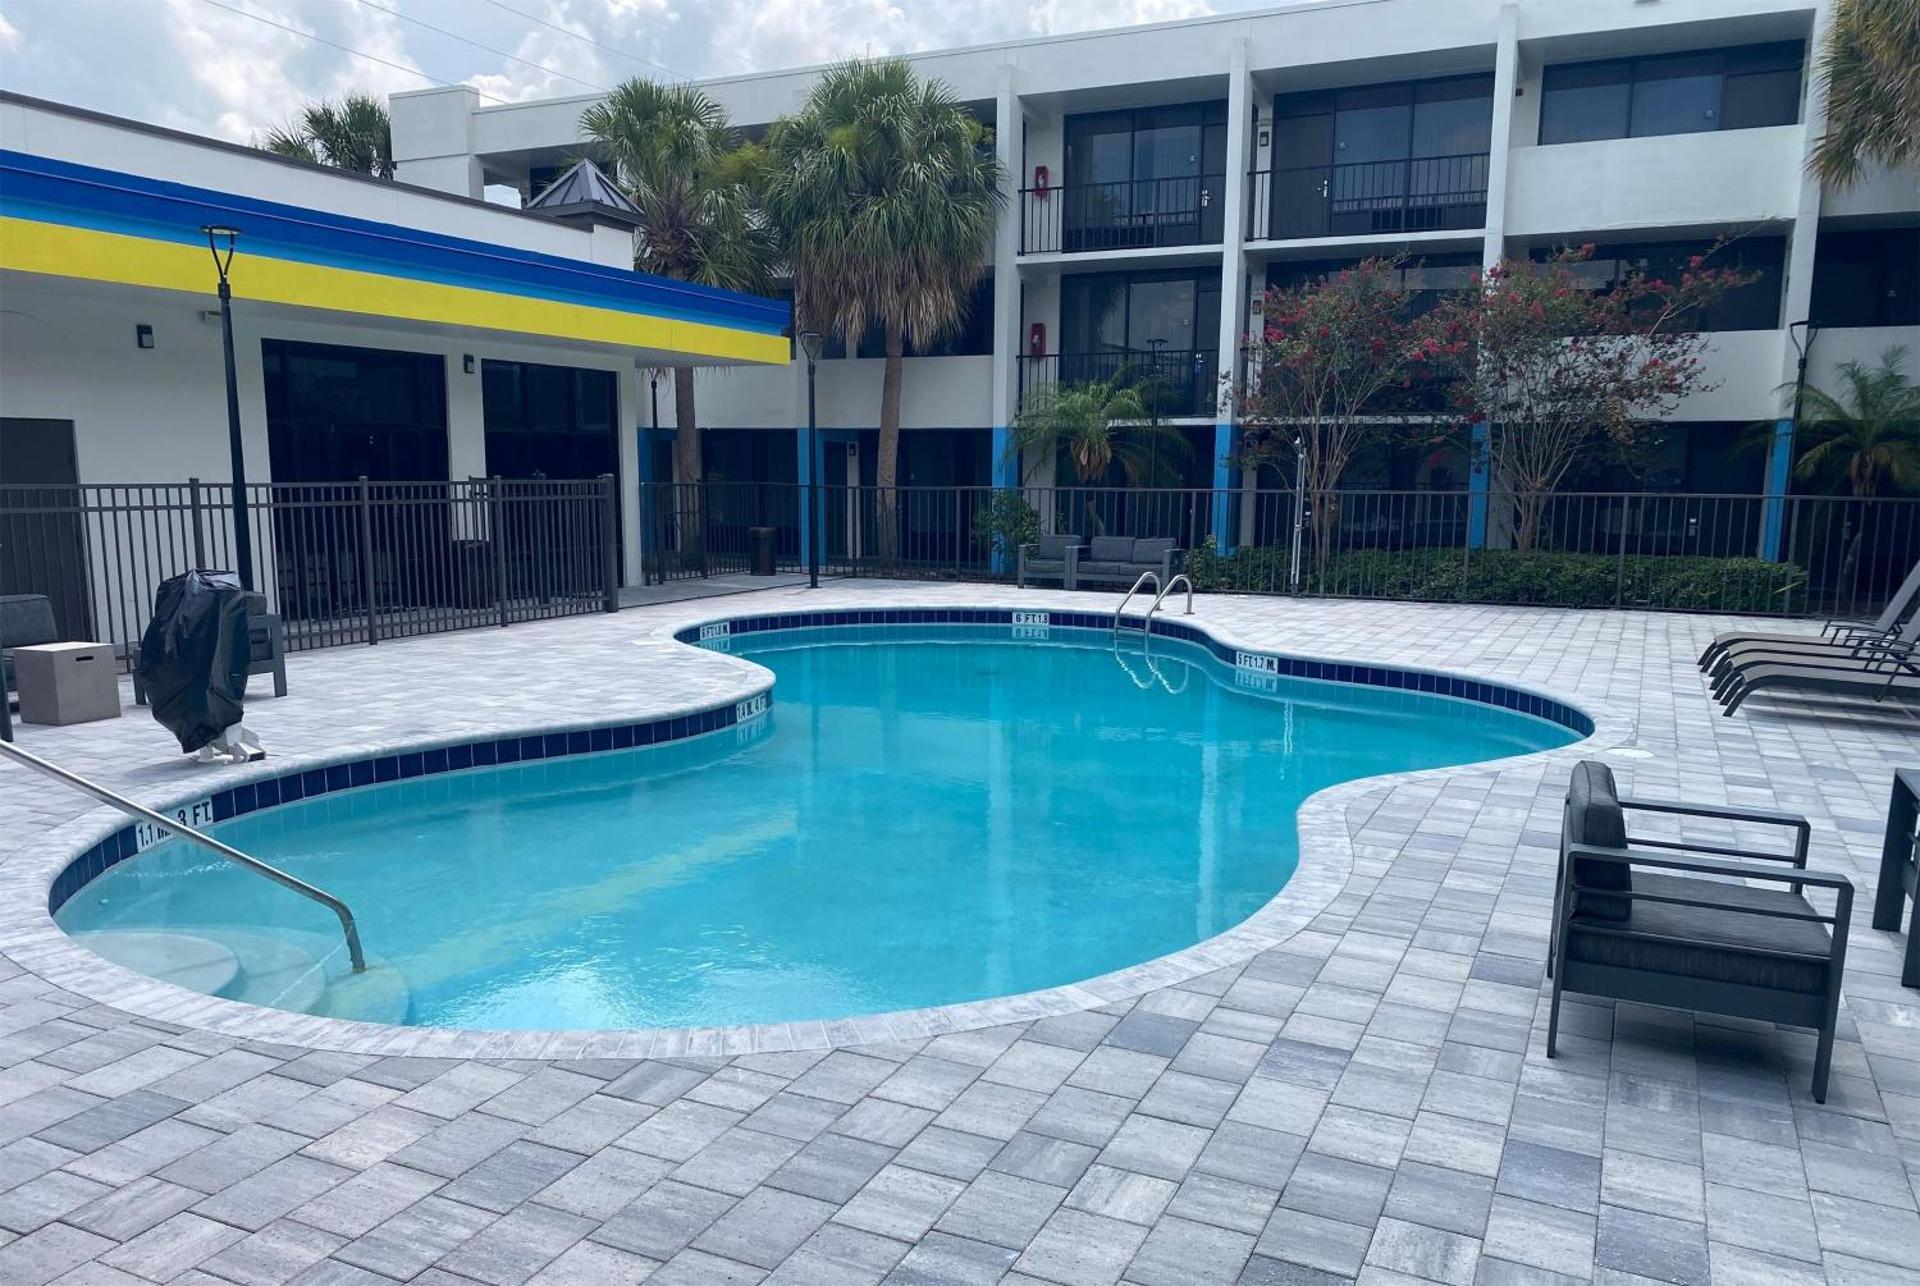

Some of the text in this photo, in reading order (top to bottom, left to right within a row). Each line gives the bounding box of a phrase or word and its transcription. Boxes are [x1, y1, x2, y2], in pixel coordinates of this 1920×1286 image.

[138, 823, 154, 847] 1.1
[177, 809, 187, 827] 3
[192, 800, 212, 826] FT.
